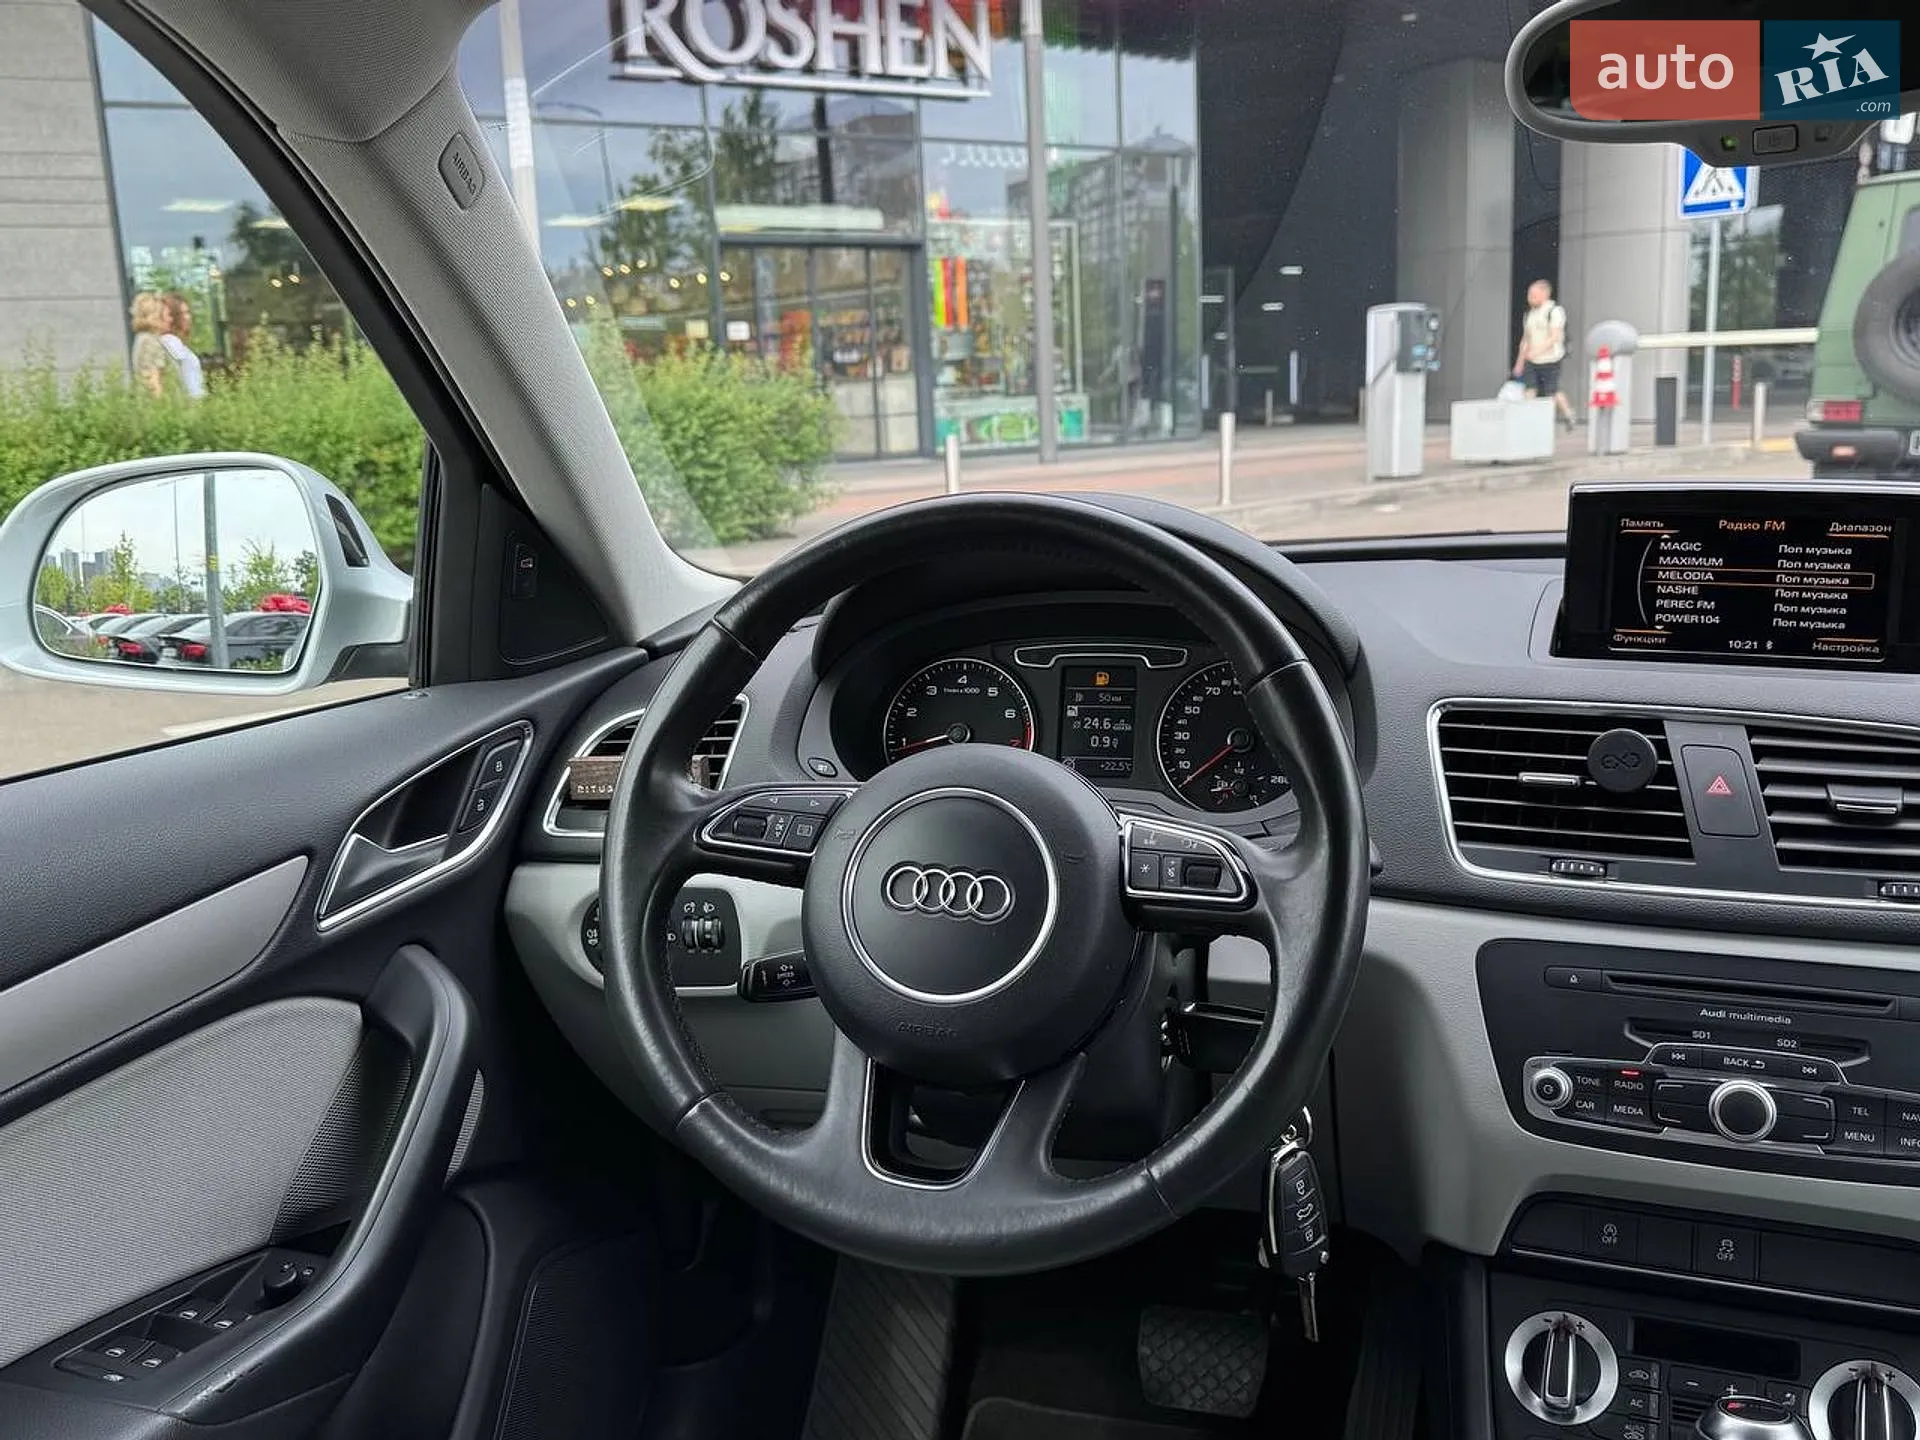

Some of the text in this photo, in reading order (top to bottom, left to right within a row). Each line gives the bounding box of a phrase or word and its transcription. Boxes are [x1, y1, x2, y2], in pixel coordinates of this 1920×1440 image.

[618, 0, 992, 83] ROSHEN
[452, 151, 477, 196] AIRBAG
[1620, 518, 1664, 528] Память
[1719, 519, 1786, 532] Радио FM
[1829, 521, 1892, 532] Диапазон
[1659, 542, 1702, 551] MAGIC
[1778, 544, 1852, 556] Поп музыка
[1658, 556, 1723, 566] MAXIMUM
[1777, 559, 1851, 571] Поп музыка
[1657, 571, 1714, 581] MELODIA
[1776, 574, 1850, 586] Поп музыка
[1657, 585, 1699, 595] NASHE
[1775, 588, 1848, 600] Поп музыка
[1656, 599, 1716, 609] PEREC FM
[1774, 603, 1847, 615] Поп музыка
[1654, 613, 1721, 624] POWER104
[1772, 617, 1846, 630] Поп музыка
[1728, 640, 1758, 649] 10:21
[1812, 641, 1880, 653] Настройка
[957, 675, 968, 684] 4
[926, 685, 937, 696] 3
[987, 686, 999, 697] 5
[1205, 686, 1220, 696] 70
[906, 707, 917, 717] 2
[1004, 709, 1017, 719] 6
[1184, 706, 1200, 714] 50
[1083, 717, 1112, 730] 24.6
[1174, 731, 1190, 740] 30
[1090, 735, 1111, 748] 0.9
[1178, 760, 1191, 769] 10
[577, 784, 614, 793] RITUA
[1700, 1008, 1791, 1024] Audi multimedia
[1692, 1030, 1711, 1040] SD1
[1776, 1038, 1797, 1048] SD2
[1723, 1056, 1750, 1067] BACK
[1576, 1075, 1600, 1086] TONE
[1614, 1080, 1644, 1090] RADIO
[1575, 1100, 1595, 1110] CAR
[1612, 1104, 1644, 1116] MEDIA
[1851, 1106, 1870, 1117] TEL
[1844, 1131, 1875, 1143] MENU
